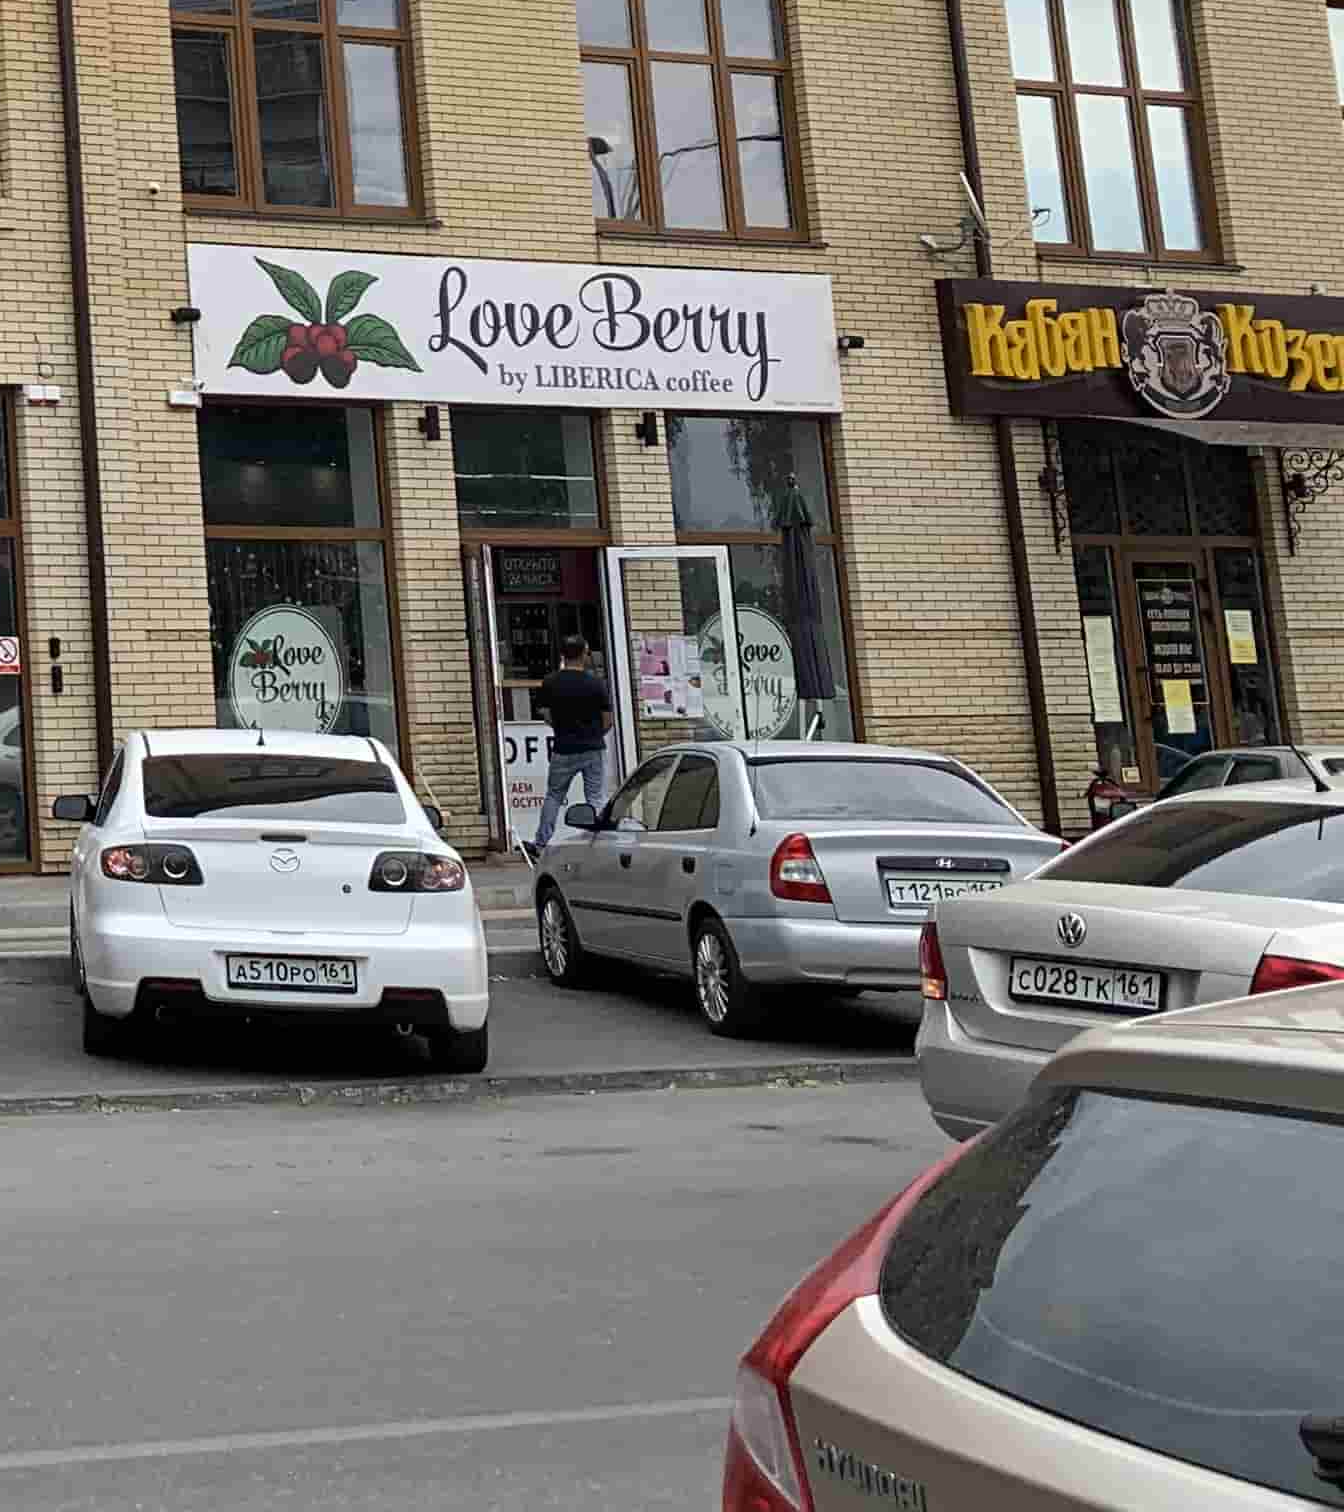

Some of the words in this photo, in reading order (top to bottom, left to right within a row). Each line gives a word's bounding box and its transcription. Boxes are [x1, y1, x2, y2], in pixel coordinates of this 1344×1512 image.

[427, 266, 580, 375] Love
[579, 272, 782, 402] Berry
[1216, 302, 1344, 392] Козе
[496, 363, 527, 394] by
[535, 364, 660, 392] LIBERICA
[665, 368, 734, 394] coffee
[272, 634, 326, 677] Love
[251, 670, 328, 720] Berry
